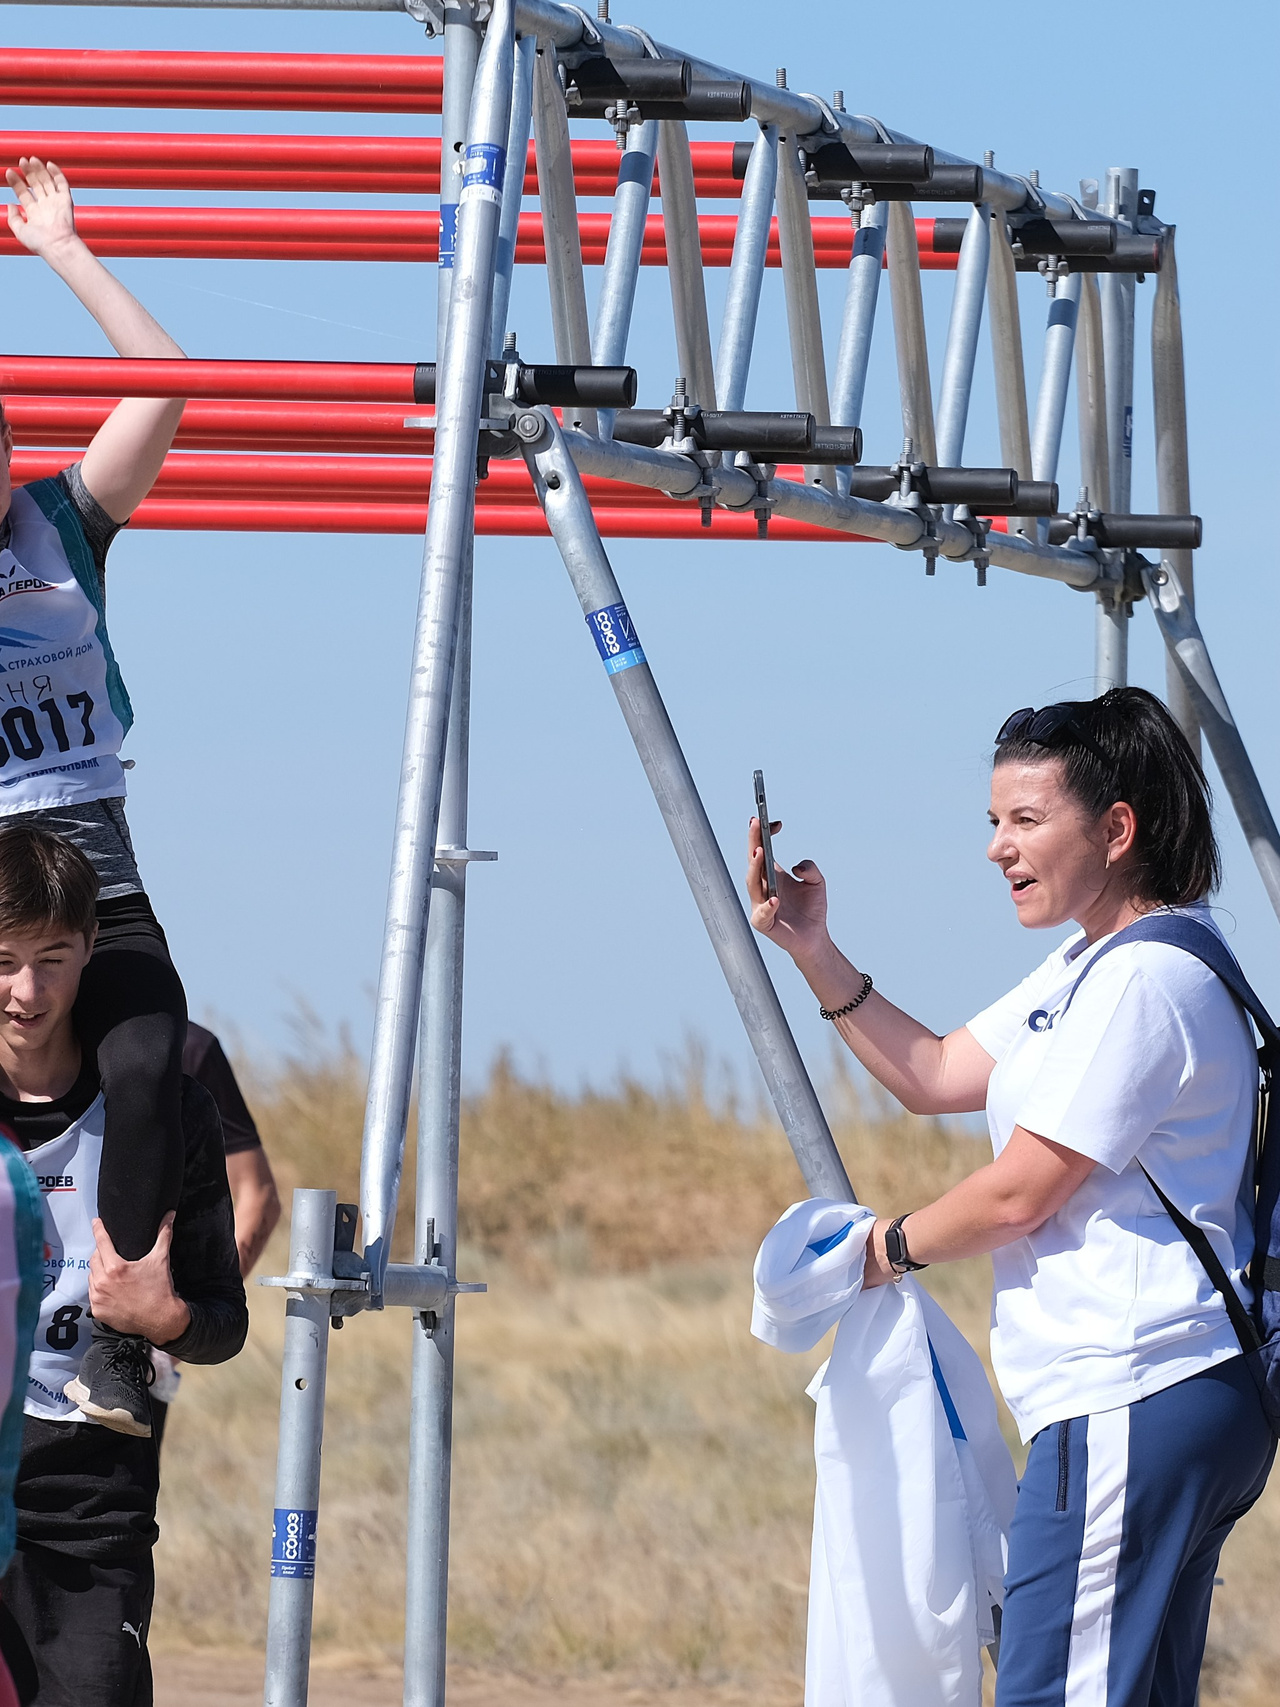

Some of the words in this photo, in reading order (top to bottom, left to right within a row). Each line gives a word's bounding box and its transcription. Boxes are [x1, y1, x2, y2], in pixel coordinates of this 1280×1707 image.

[9, 578, 52, 592] ГЕРО
[8, 647, 73, 671] СТРАХОВОЙ
[75, 642, 94, 658] ДОМ
[37, 1175, 74, 1188] РОЕВ
